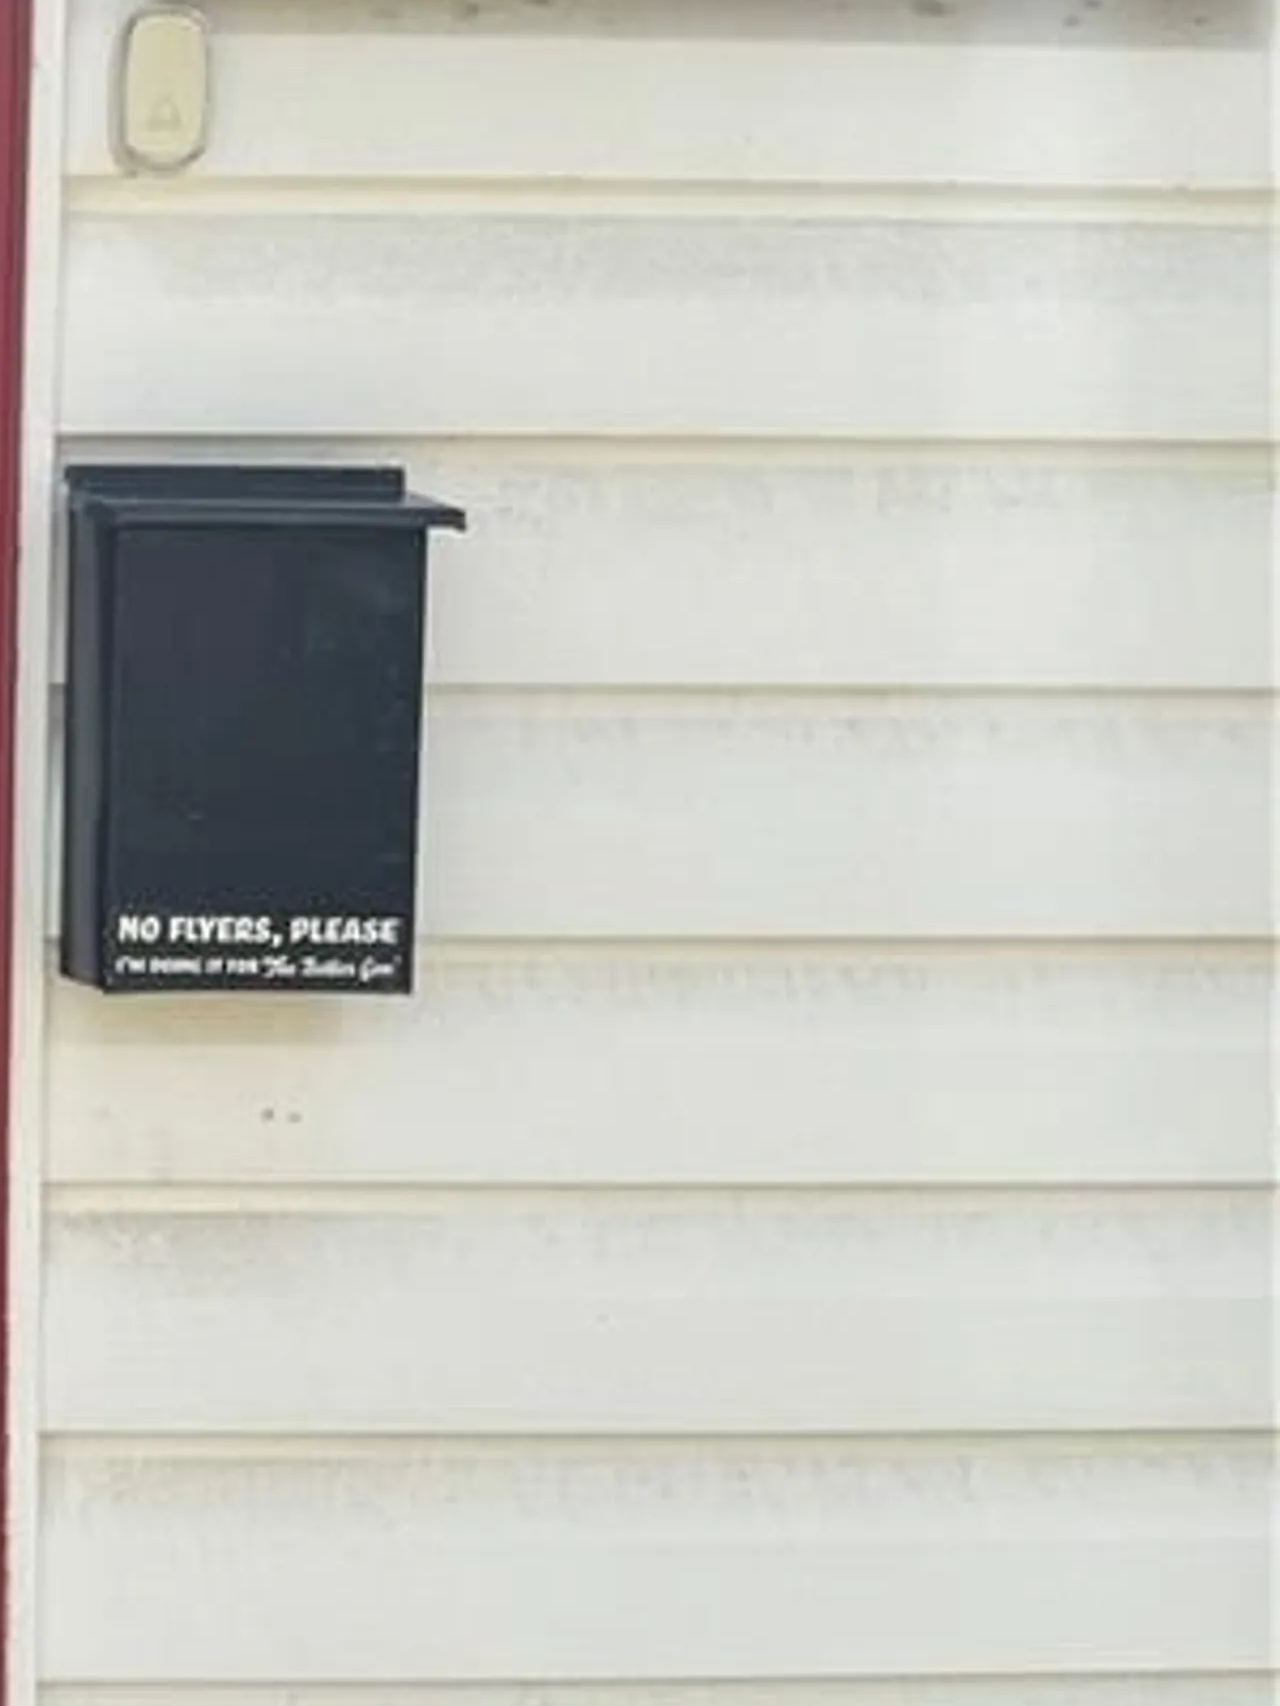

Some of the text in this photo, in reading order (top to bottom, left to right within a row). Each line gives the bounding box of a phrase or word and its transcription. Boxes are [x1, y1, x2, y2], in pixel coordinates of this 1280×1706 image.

[118, 915, 402, 948] NO FLYERS, PLEASE
